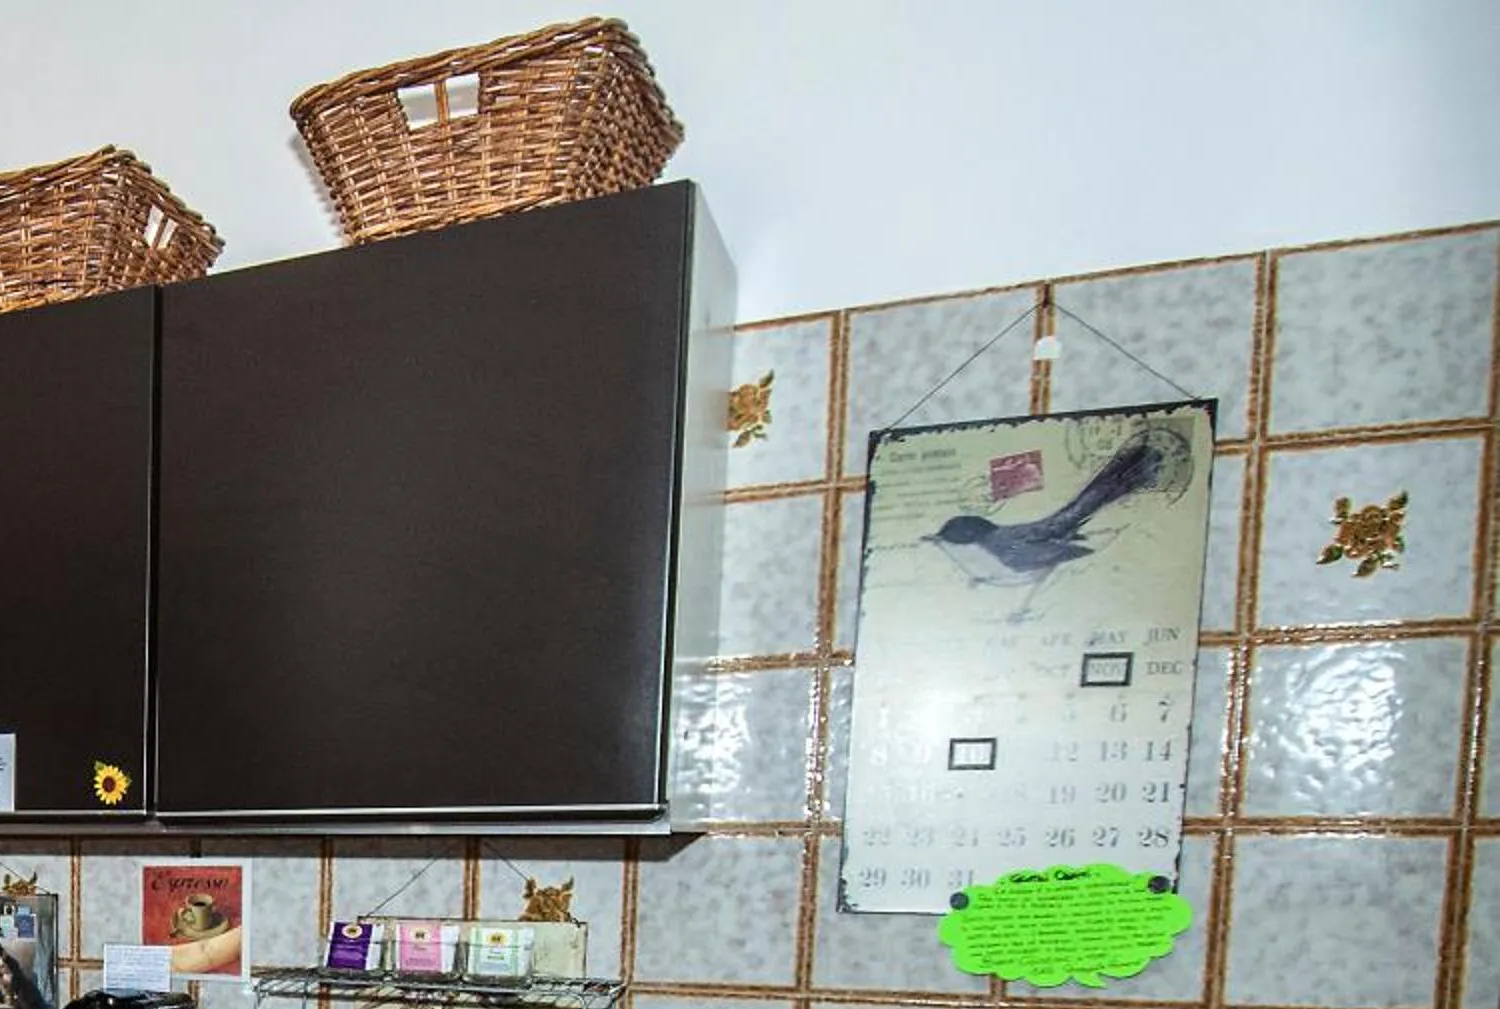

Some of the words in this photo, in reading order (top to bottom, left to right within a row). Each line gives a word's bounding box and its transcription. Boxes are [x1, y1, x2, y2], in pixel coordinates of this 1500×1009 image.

[1144, 627, 1180, 645] JUN
[1147, 661, 1182, 674] DEC
[1158, 698, 1174, 722] 7
[1100, 740, 1128, 762] 13
[1143, 739, 1172, 761] 14
[1049, 785, 1076, 804] 19
[1096, 782, 1128, 802] 20
[1142, 782, 1169, 802] 21
[998, 826, 1026, 847] 25
[1046, 828, 1075, 848] 26
[1092, 826, 1120, 847] 27
[1137, 828, 1169, 848] 28
[859, 867, 886, 889] 29
[900, 868, 931, 889] 30
